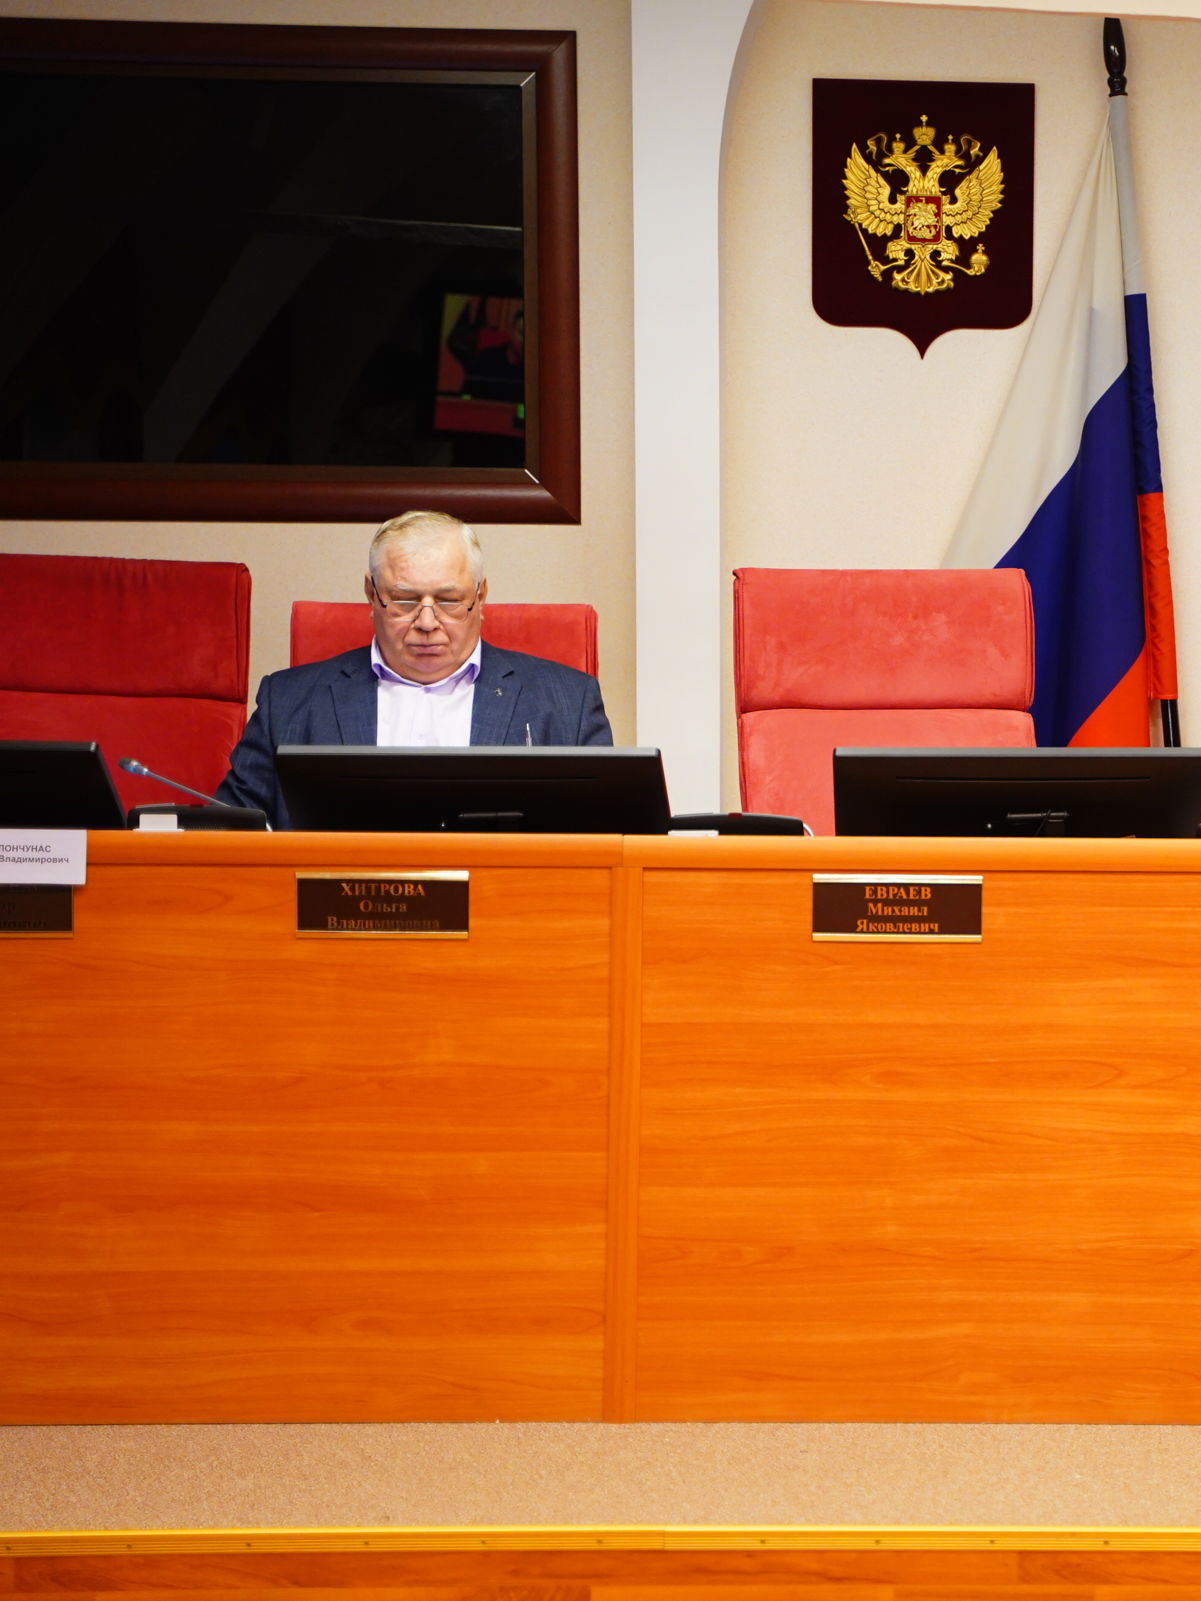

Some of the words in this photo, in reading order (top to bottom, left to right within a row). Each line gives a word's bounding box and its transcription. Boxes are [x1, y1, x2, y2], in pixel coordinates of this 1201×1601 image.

[340, 883, 425, 896] ХИТРОВА
[864, 886, 932, 899] ЕВРАЕВ
[359, 899, 408, 913] Ольга
[867, 902, 929, 916] Михаил
[327, 916, 440, 930] Владимировна
[856, 919, 939, 933] Яковлевич
